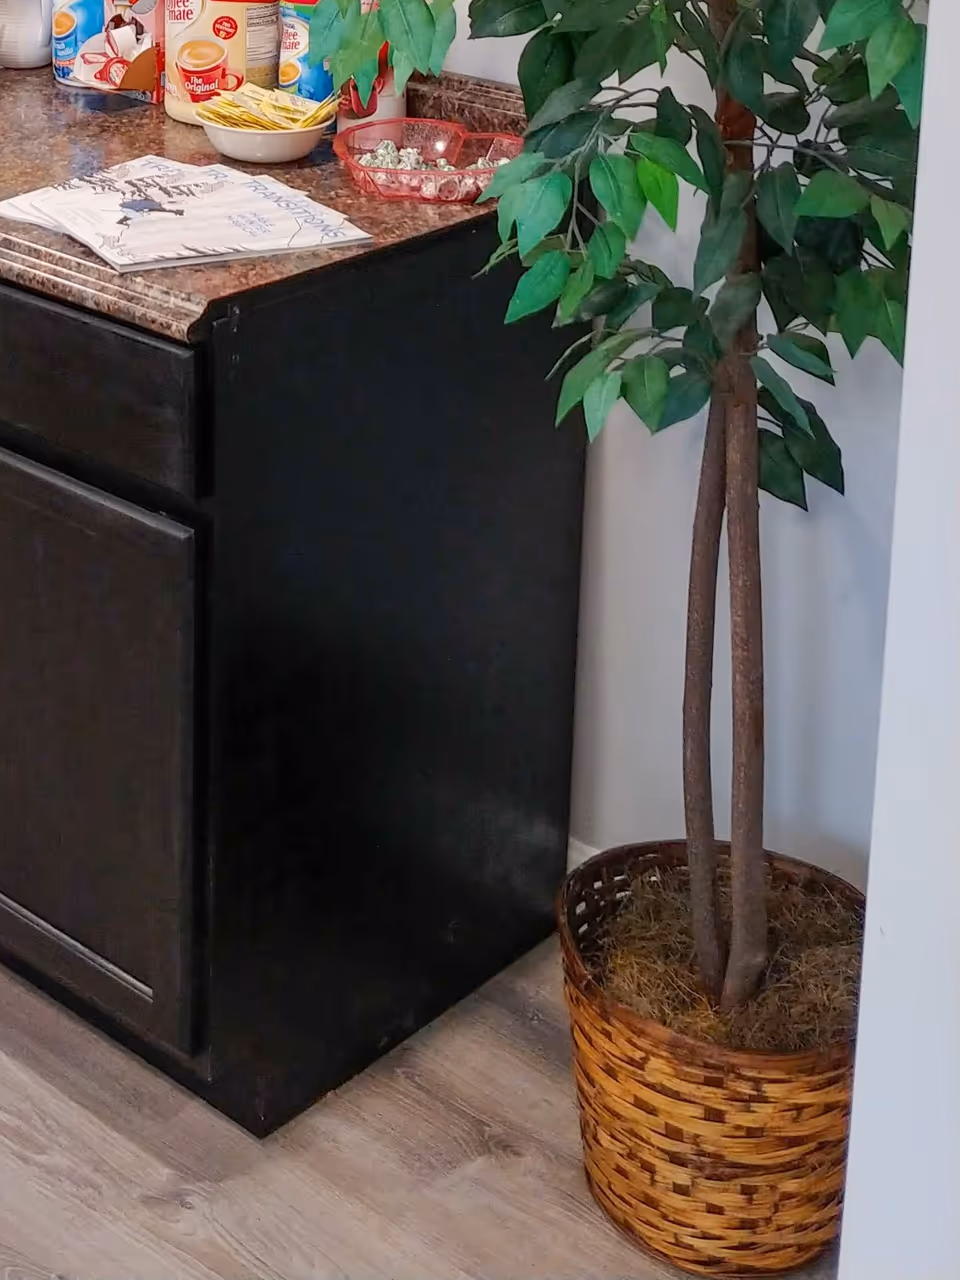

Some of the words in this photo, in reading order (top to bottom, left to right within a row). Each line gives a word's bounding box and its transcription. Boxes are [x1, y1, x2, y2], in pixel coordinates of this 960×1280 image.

[168, 8, 194, 21] mate
[184, 78, 219, 95] Original
[190, 76, 203, 84] The
[240, 178, 346, 239] TRANSITIONS
